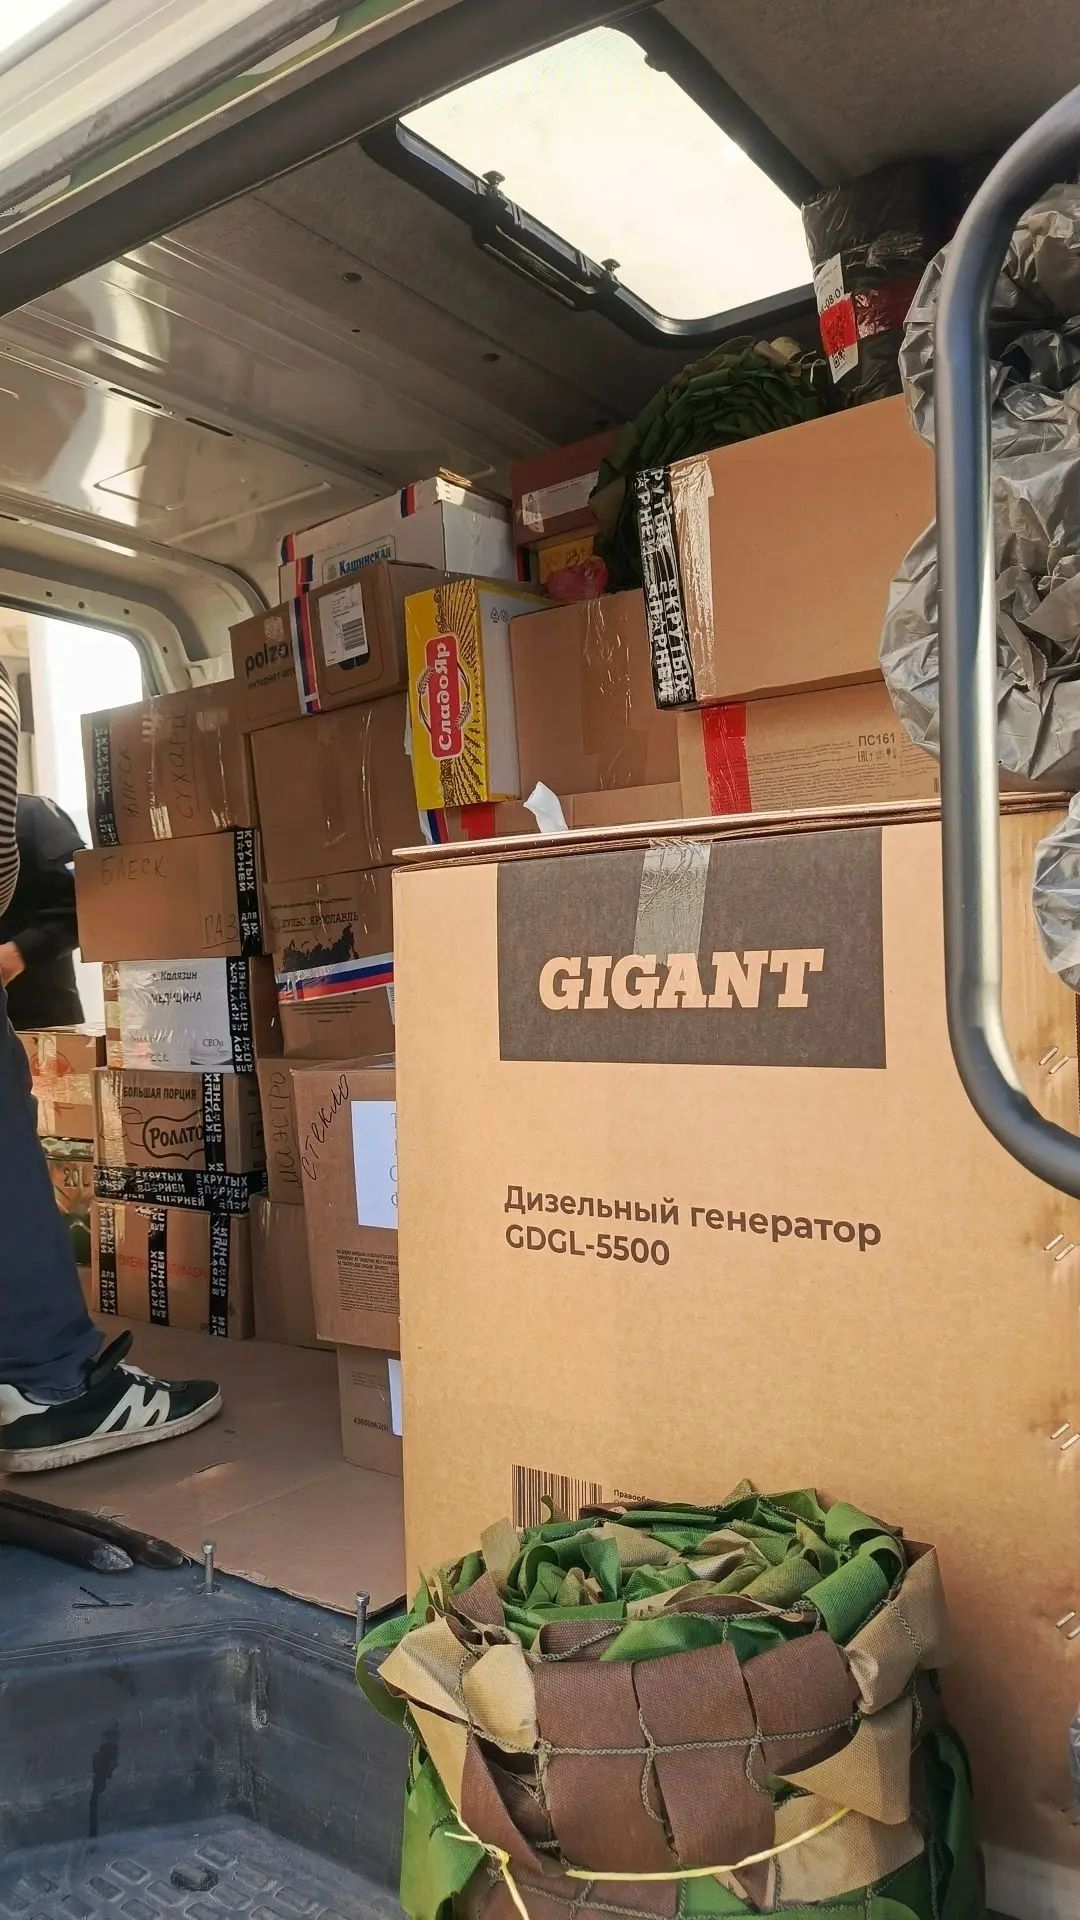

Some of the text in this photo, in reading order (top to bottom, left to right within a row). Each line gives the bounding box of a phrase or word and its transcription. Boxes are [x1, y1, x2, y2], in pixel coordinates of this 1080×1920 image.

[339, 547, 391, 576] Кашинская
[664, 594, 692, 699] КРУТЫХ
[858, 732, 895, 747] ПС161
[101, 855, 167, 886] БЛЕСК
[244, 830, 255, 891] КРУТЫХ
[204, 913, 239, 945] ГАЗ
[160, 970, 198, 981] Калязин
[230, 961, 240, 1021] КРУТЫХ
[539, 948, 825, 1012] GIGANT
[123, 1086, 197, 1101] БОЛЬШАЯ ПОРЦИЯ
[204, 1073, 213, 1132] КРУТЫХ
[149, 1124, 205, 1149] РОЛЛТО
[63, 1167, 90, 1188] 20L
[142, 1171, 184, 1182] КРУТЫХ
[203, 1174, 248, 1187] КРУТЫХ
[504, 1185, 882, 1252] Дизельный генератор
[212, 1227, 220, 1286] КРУТЫХ
[505, 1223, 670, 1266] GDGL-5500
[150, 1250, 159, 1308] КРУТЫХ
